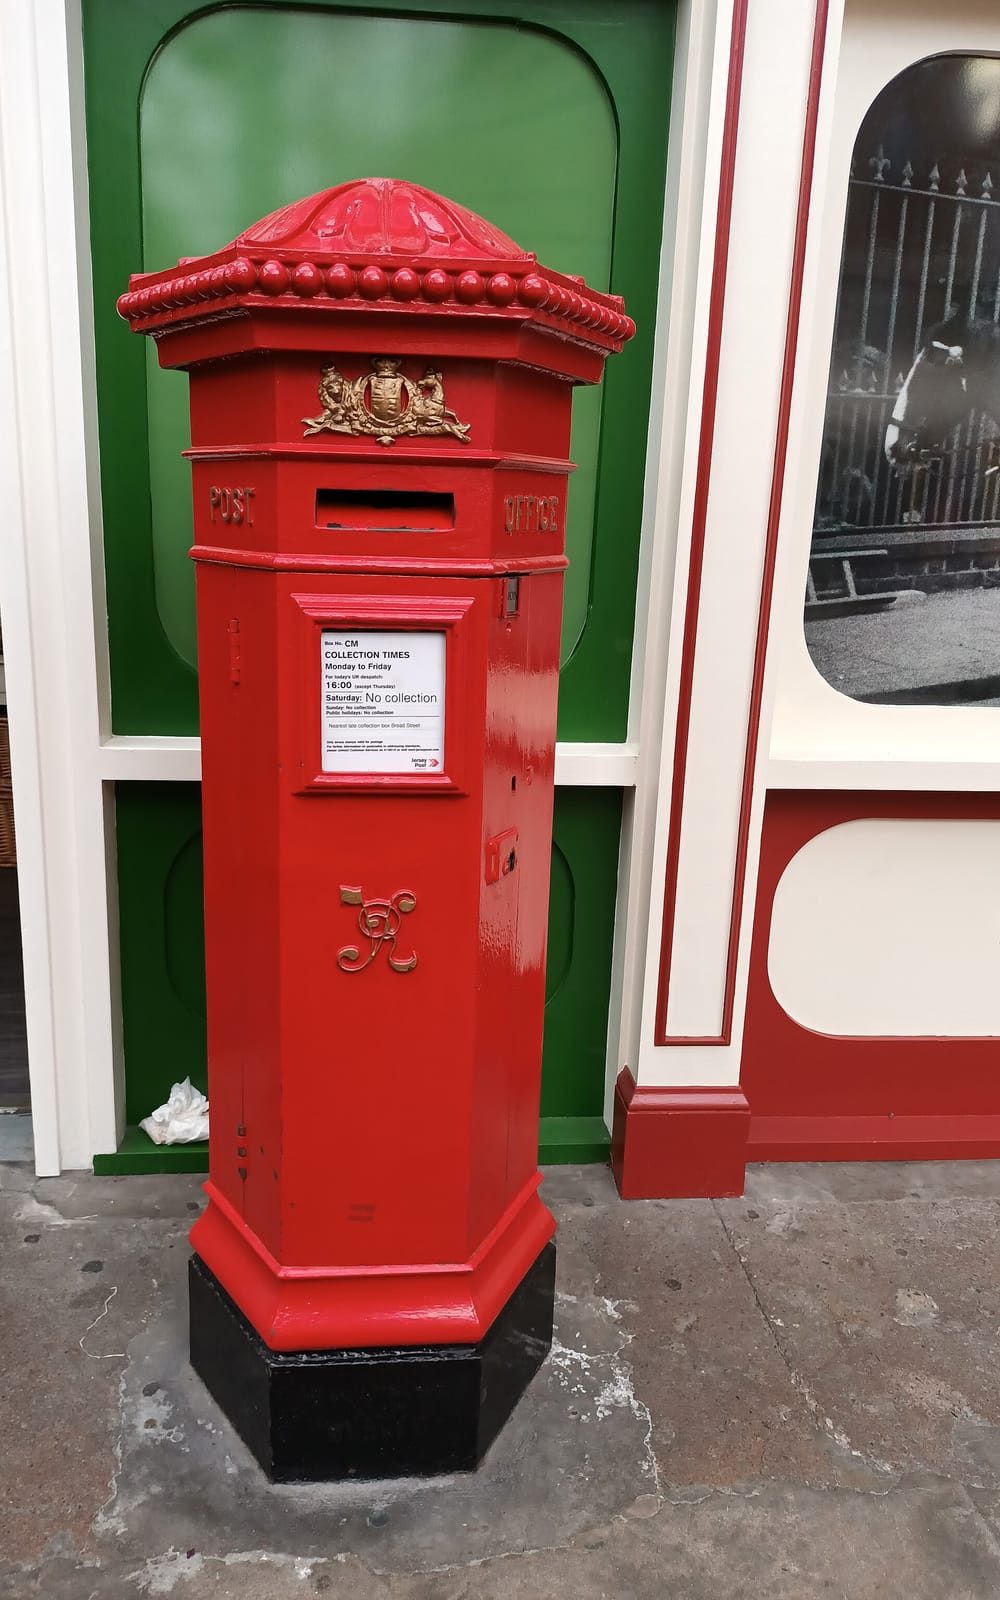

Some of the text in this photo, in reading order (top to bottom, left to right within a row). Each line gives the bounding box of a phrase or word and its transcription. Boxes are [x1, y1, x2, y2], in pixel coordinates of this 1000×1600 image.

[209, 486, 256, 527] POST
[504, 495, 559, 533] OFFICE
[344, 640, 359, 648] CM
[325, 651, 410, 659] COLLECTION TIMES
[325, 663, 356, 671] Monday
[368, 662, 392, 671] Friday
[326, 681, 352, 689] 16:00
[326, 692, 437, 703] Saturday: No collection
